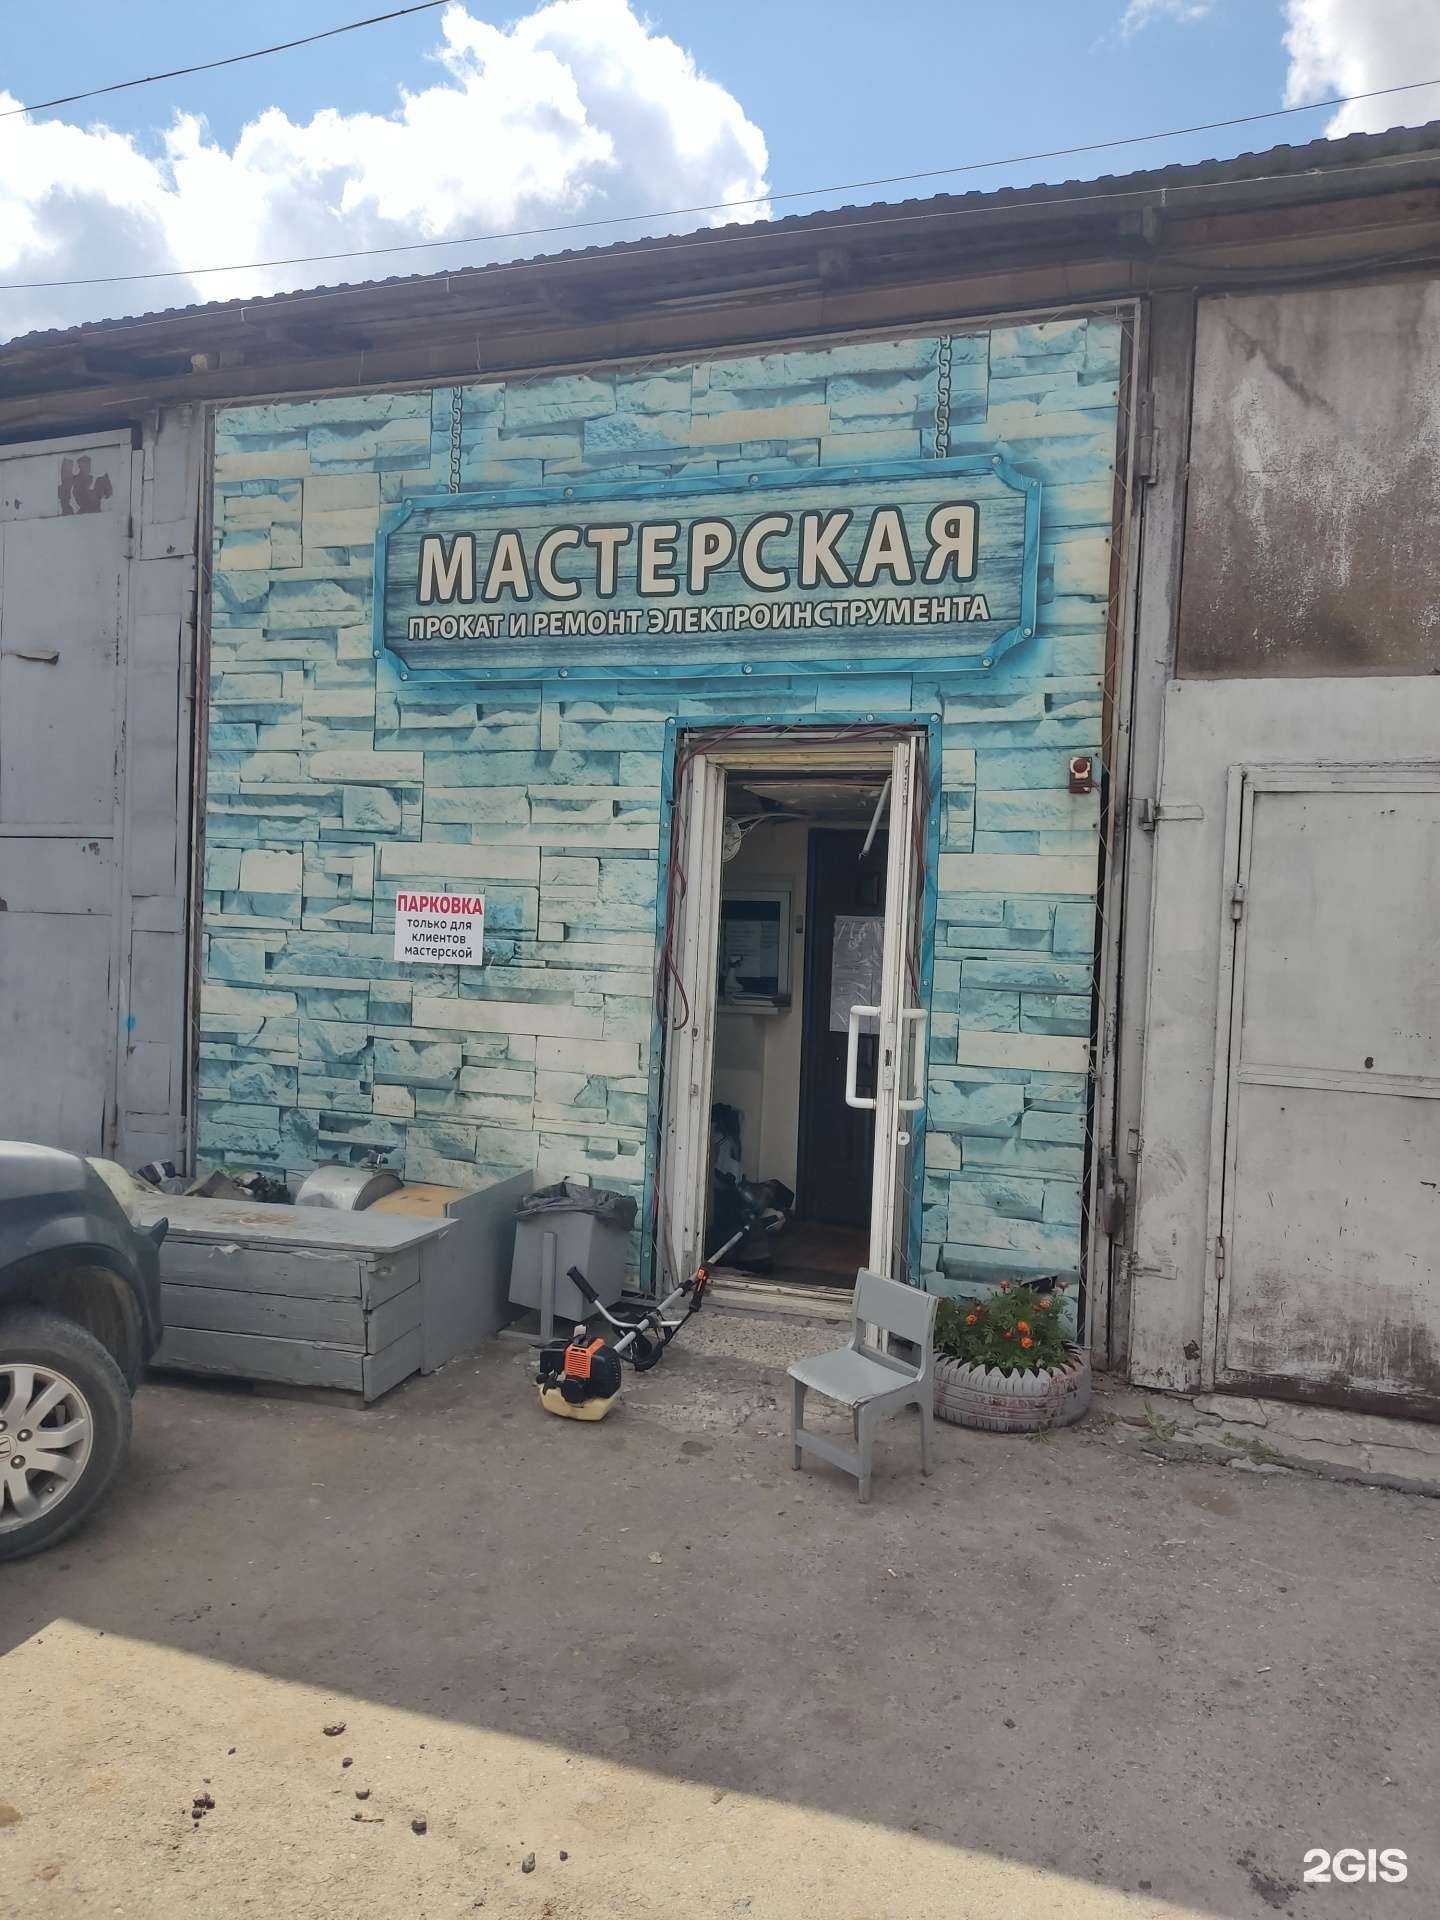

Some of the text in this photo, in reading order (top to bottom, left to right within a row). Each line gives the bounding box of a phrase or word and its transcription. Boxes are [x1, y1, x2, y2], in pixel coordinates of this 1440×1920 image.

[418, 501, 979, 604] МАСТЕРСКАЯ
[408, 594, 991, 640] ПРОКАТ И РЕМОНТ ЭЛЕКТРОИНСТРУМЕНТА
[397, 894, 483, 915] ПАРКОВКА
[407, 919, 472, 931] только для
[412, 933, 466, 944] клиентов
[404, 946, 472, 960] мастерской
